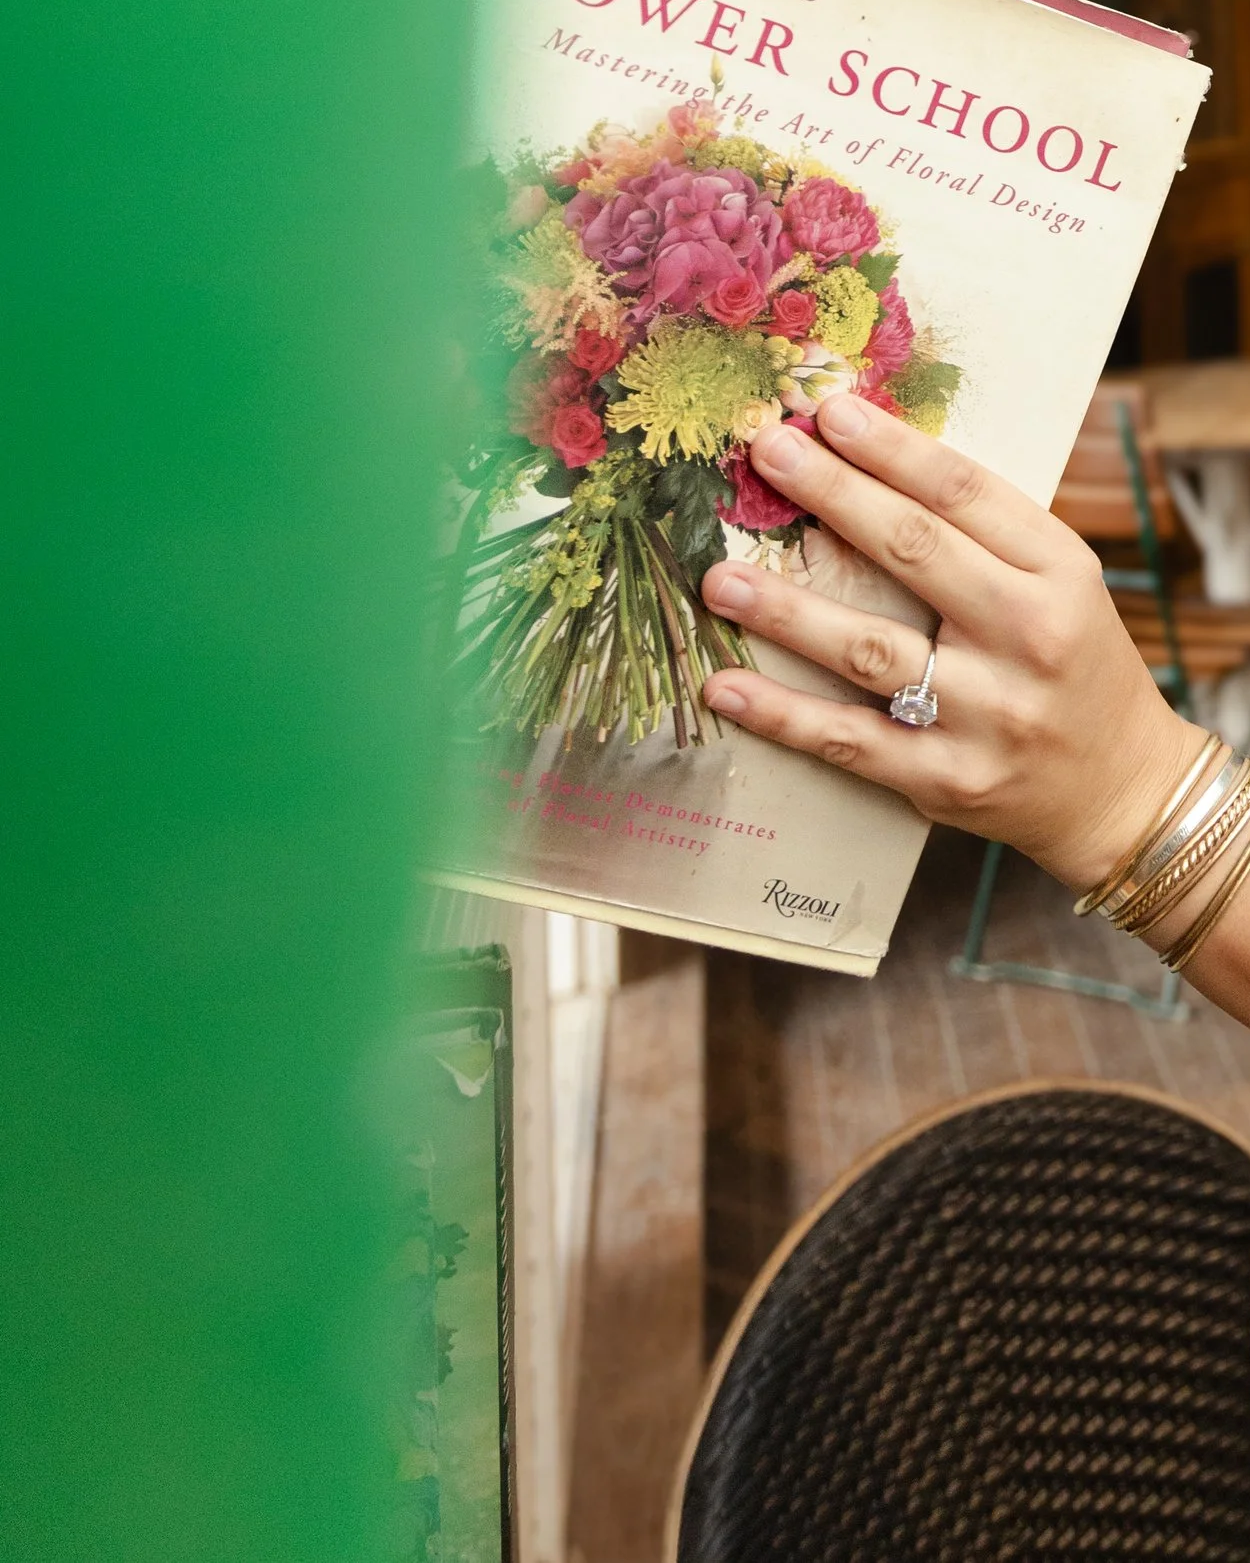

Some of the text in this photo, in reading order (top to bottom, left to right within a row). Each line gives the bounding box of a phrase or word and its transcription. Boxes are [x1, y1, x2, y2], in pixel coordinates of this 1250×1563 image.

[542, 27, 1087, 234] Mastering the Art of Floral Design
[828, 49, 1122, 192] SCHOOL
[536, 770, 615, 805] Florist
[625, 792, 778, 841] Demonstrates
[540, 799, 613, 832] Floral
[621, 818, 712, 856] Artistry
